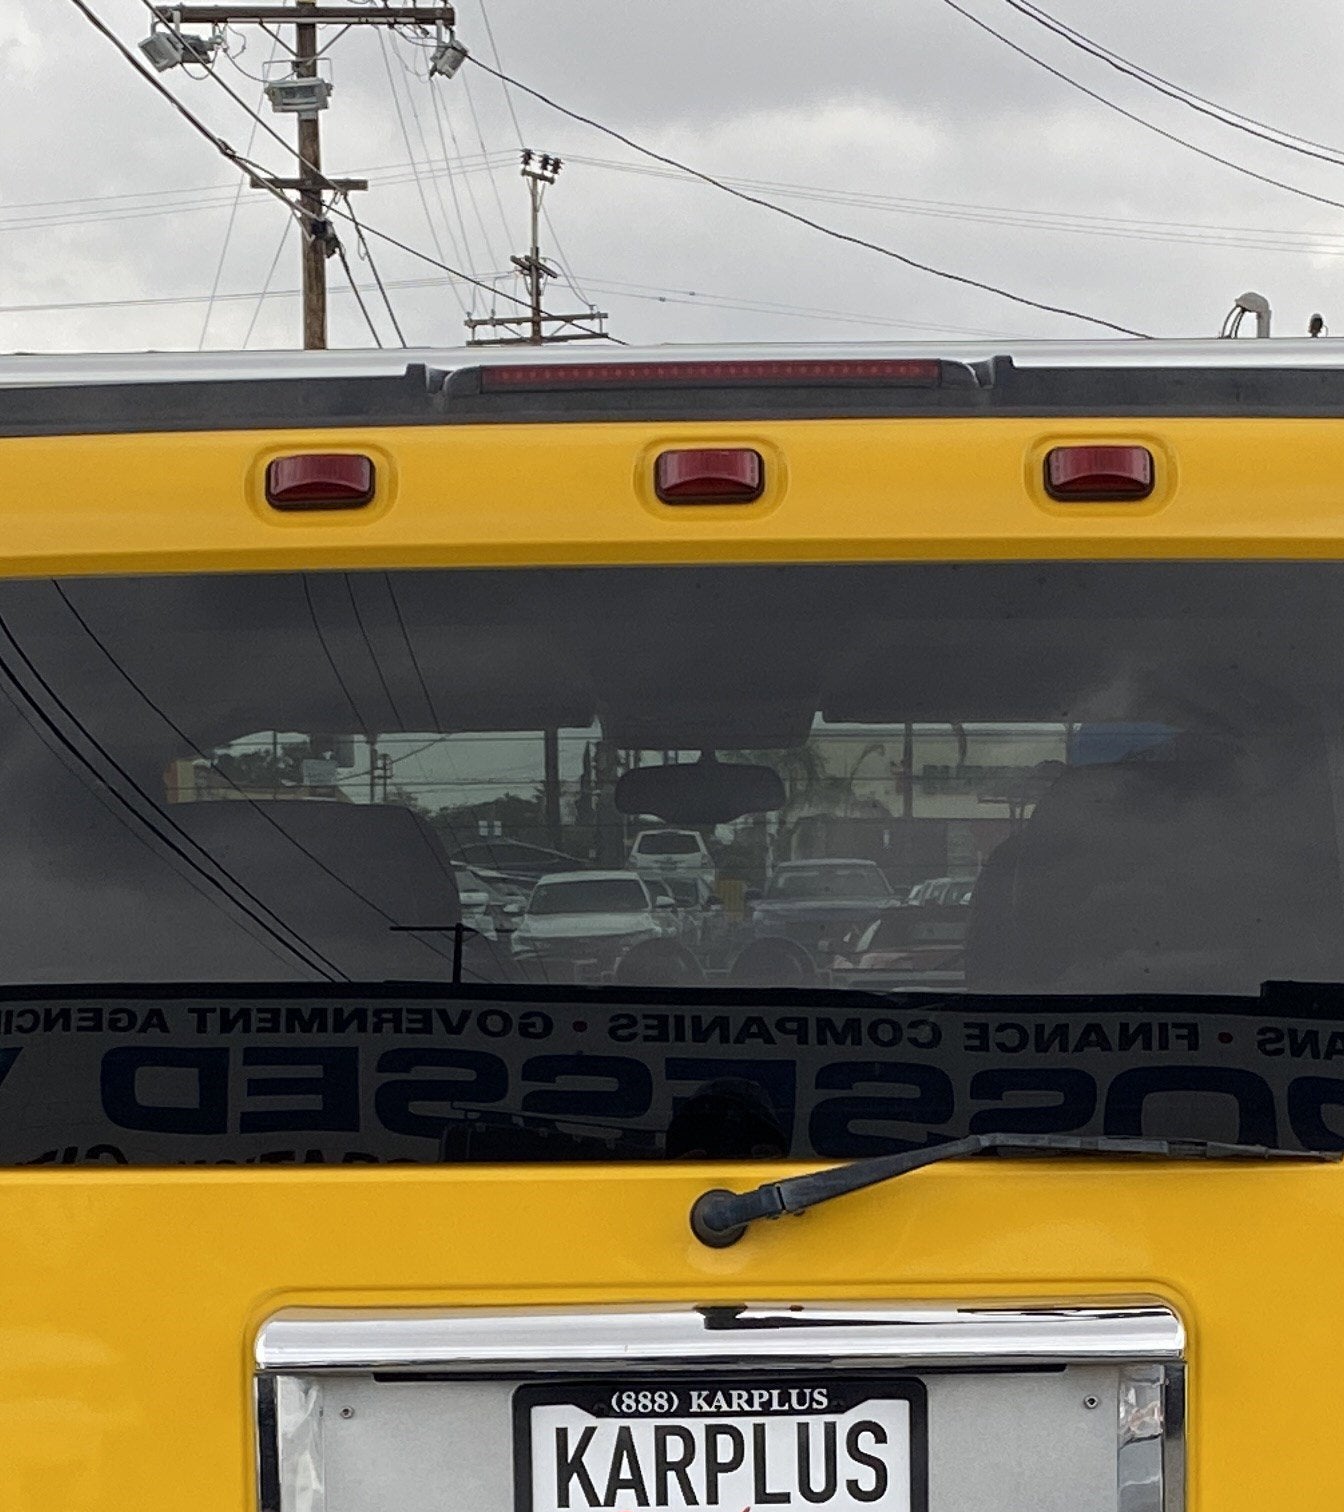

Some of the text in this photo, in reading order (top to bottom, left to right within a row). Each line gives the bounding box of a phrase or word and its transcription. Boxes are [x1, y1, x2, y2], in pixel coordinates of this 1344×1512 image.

[610, 1388, 830, 1414] (888) KARPLUS
[555, 1420, 889, 1509] KARPLUS
